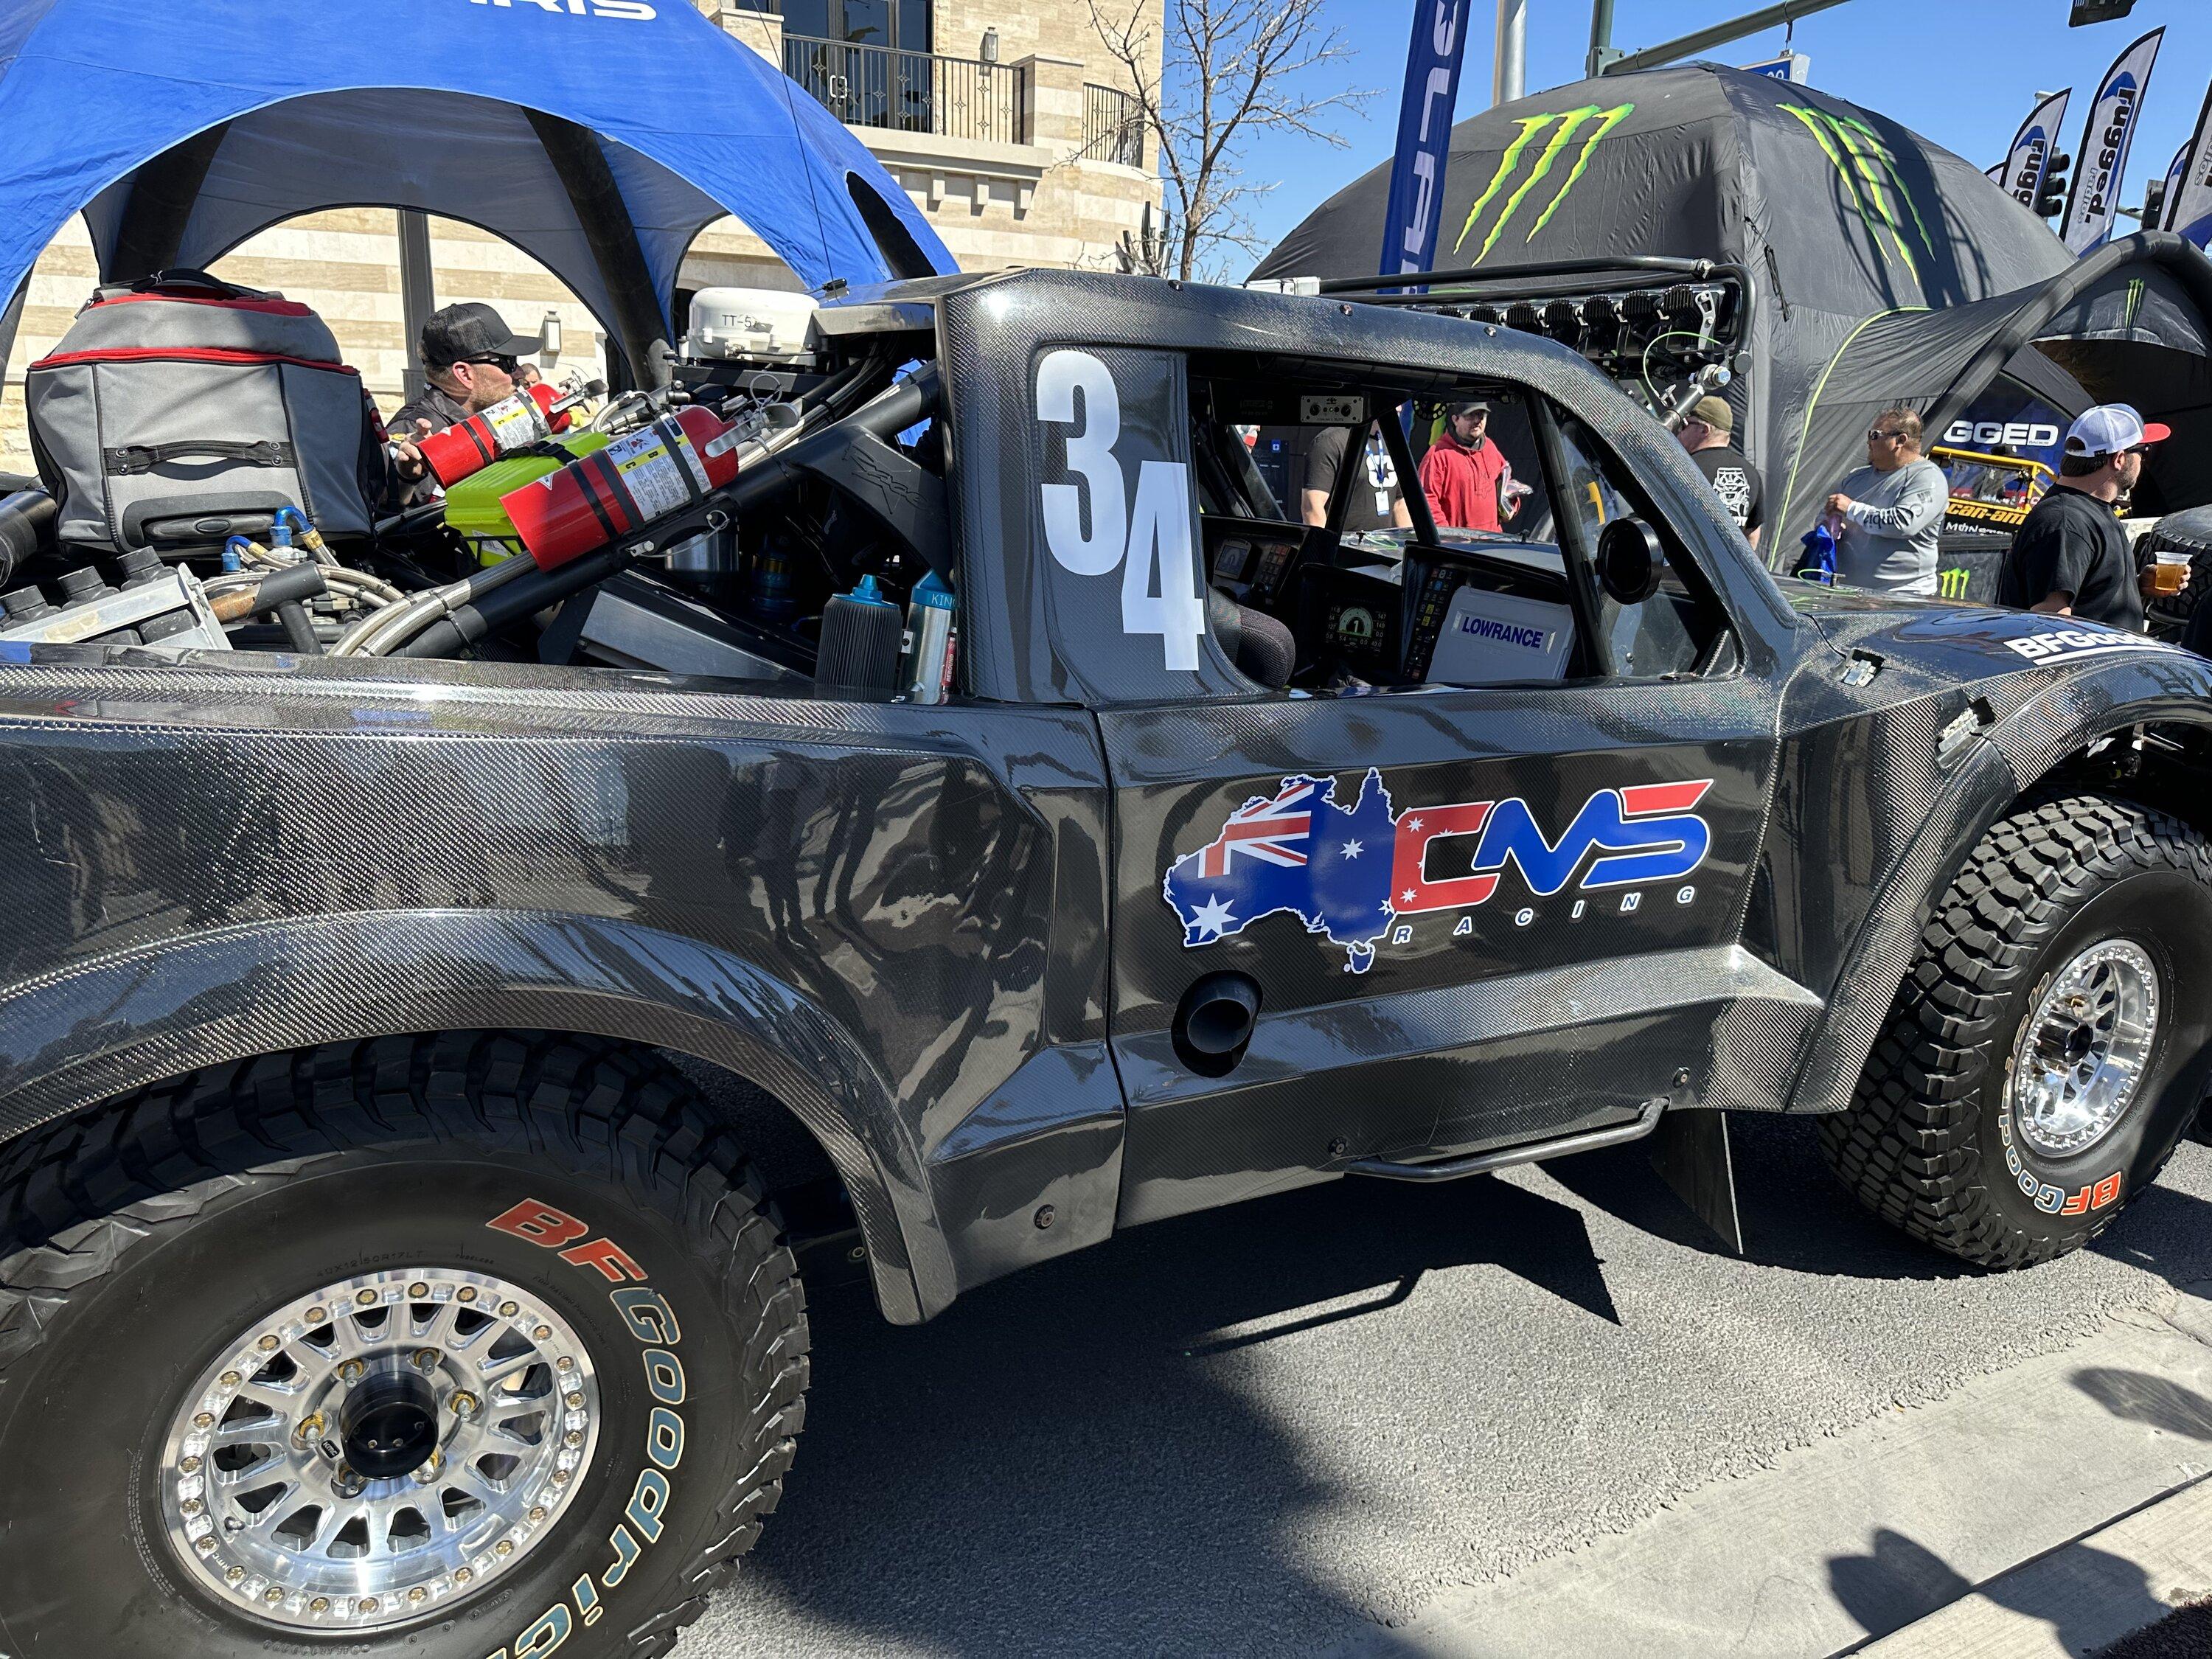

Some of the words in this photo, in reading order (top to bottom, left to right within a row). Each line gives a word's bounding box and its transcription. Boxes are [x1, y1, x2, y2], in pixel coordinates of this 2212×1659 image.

[648, 451, 659, 459] B
[1036, 349, 1206, 671] 34
[1946, 503, 2027, 526] can-am
[931, 593, 956, 609] KIN
[1353, 620, 1359, 633] 1
[1461, 616, 1544, 649] LOWRANCE
[946, 654, 954, 683] REBOUND
[1391, 779, 1714, 915] CMS
[1392, 885, 1696, 945] RACING
